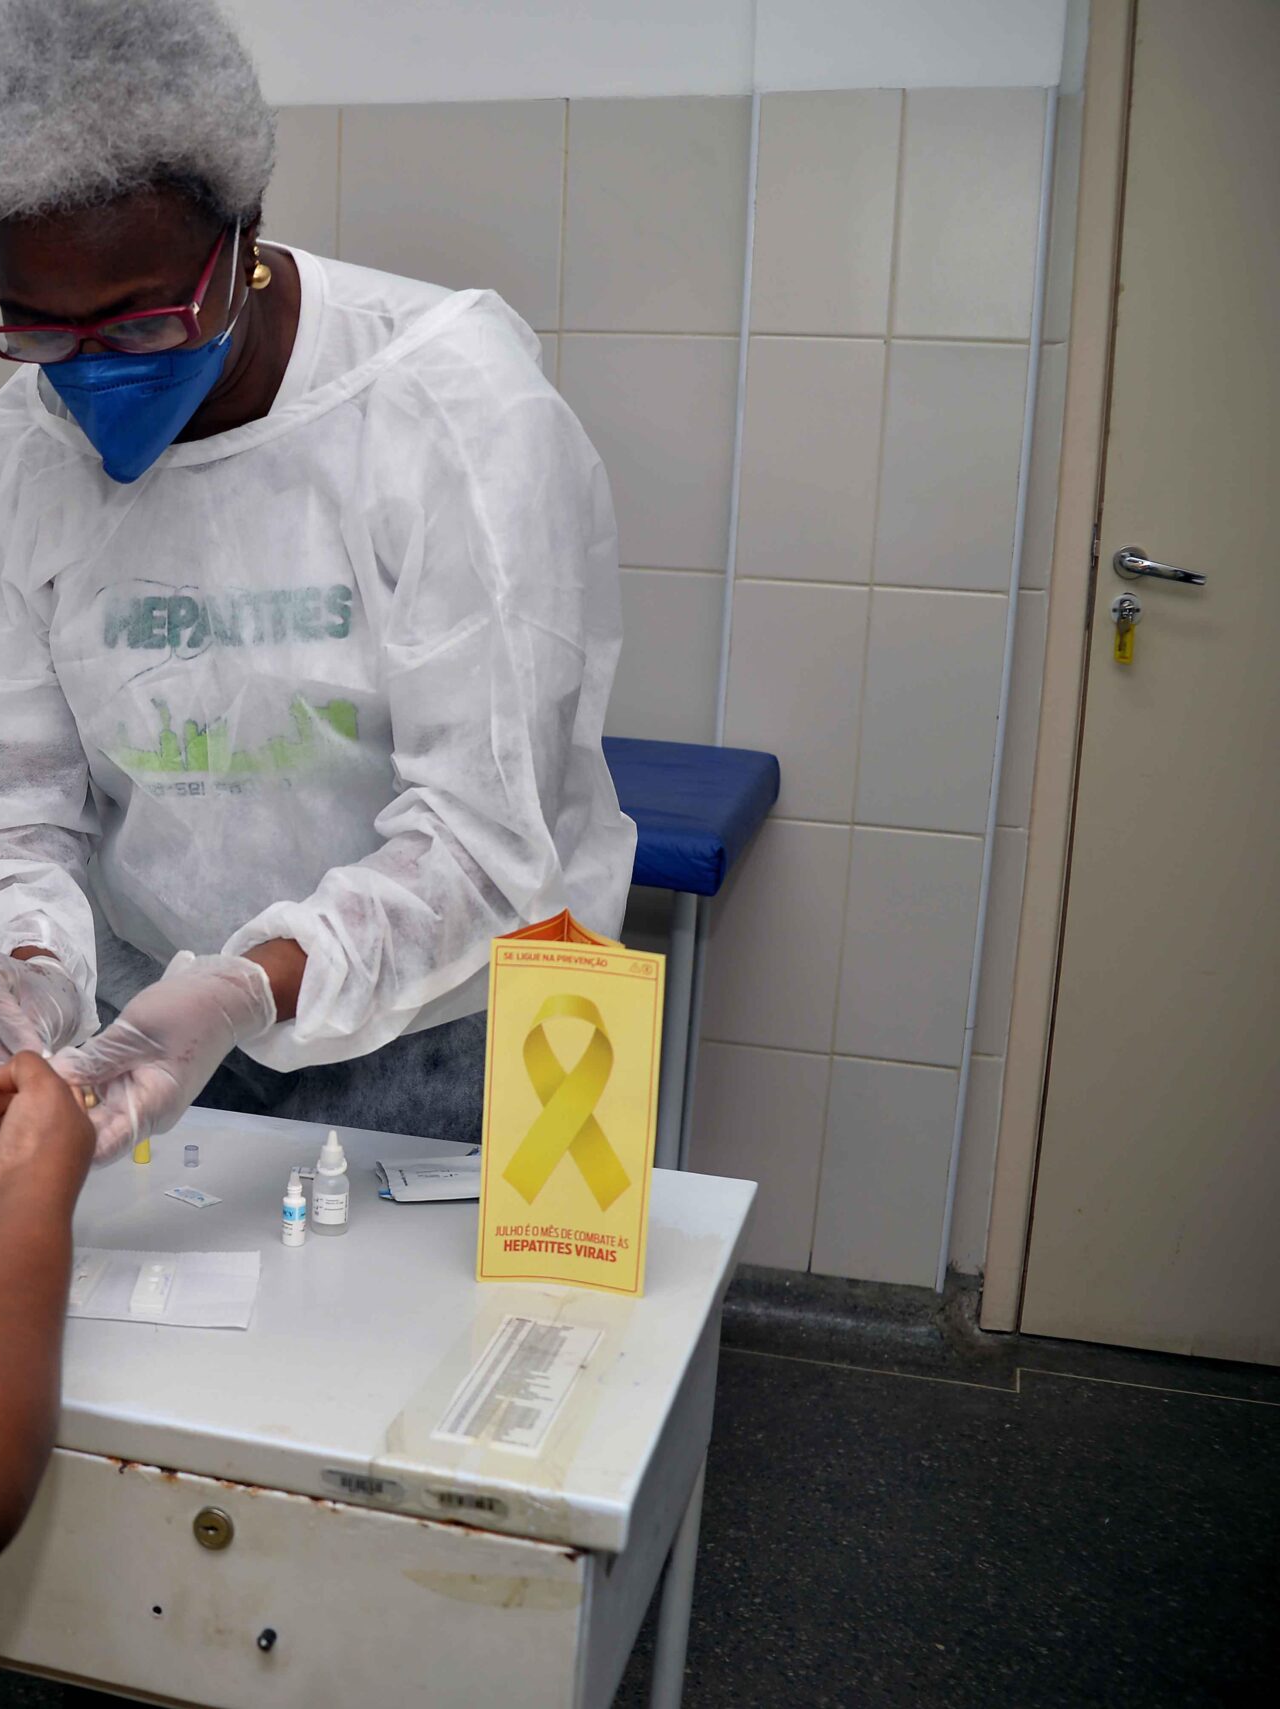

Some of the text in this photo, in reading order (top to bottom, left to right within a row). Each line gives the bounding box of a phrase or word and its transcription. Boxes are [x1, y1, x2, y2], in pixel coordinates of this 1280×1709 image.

[504, 952, 513, 960] SE
[543, 954, 555, 962] NA
[557, 955, 608, 968] PREVENÇÃO
[495, 1223, 629, 1249] JULHO É O MÊS DE COMBATE ÀS
[503, 1239, 617, 1263] HEPATITES VIRAIS
